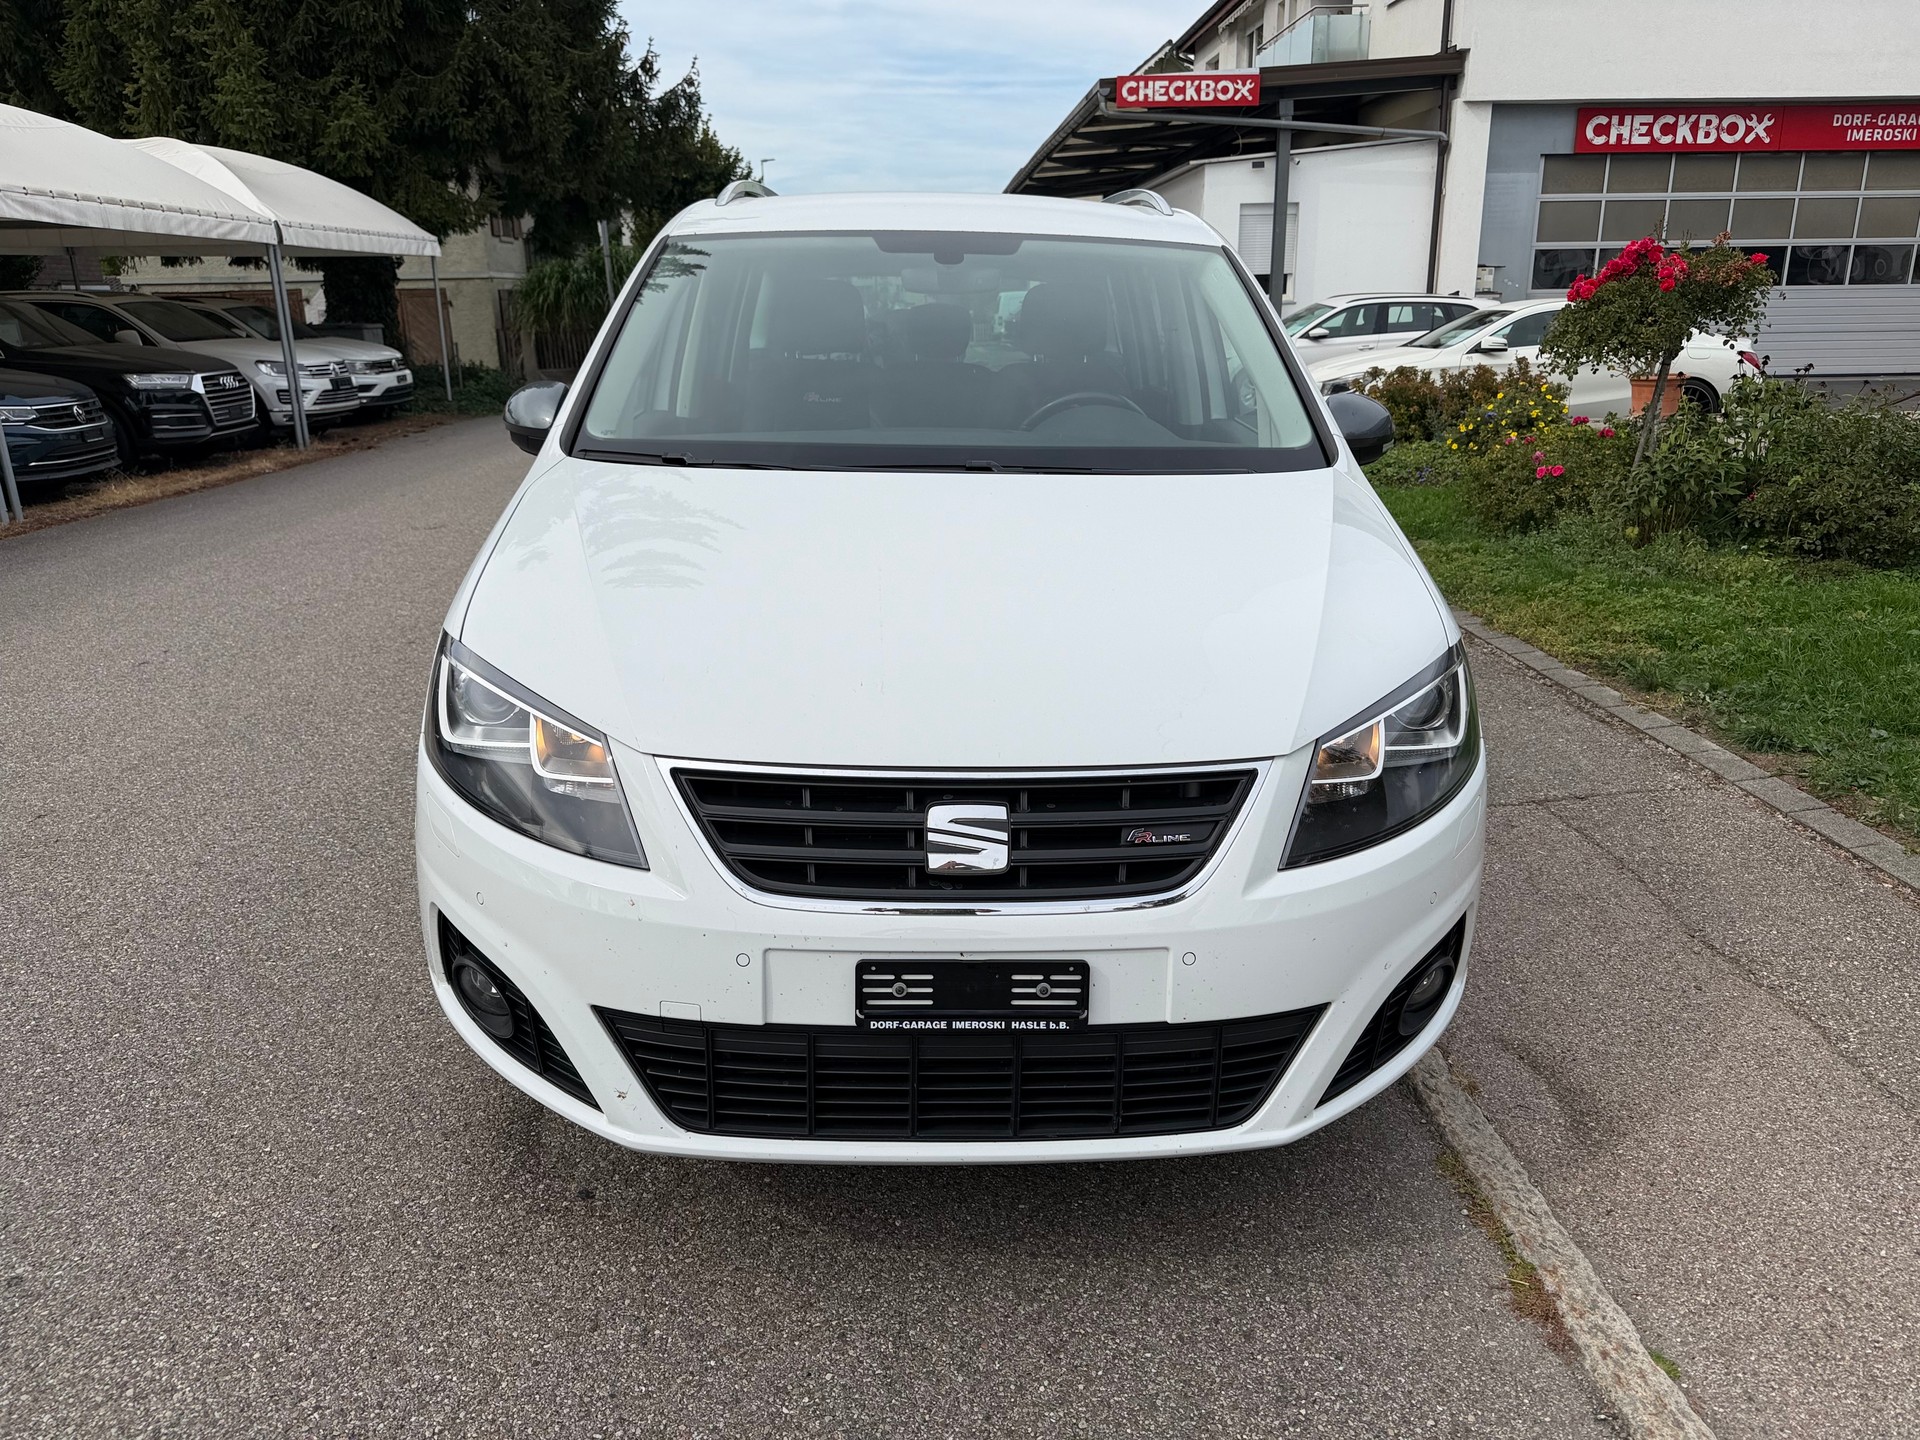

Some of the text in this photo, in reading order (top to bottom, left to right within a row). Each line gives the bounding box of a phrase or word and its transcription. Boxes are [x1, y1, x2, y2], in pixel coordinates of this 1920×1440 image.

[1121, 79, 1255, 102] CHECKBOX
[1832, 113, 1920, 127] DORF-GARA
[1585, 113, 1775, 146] CHECKBOX
[1846, 128, 1918, 142] IMEROSKI
[870, 1021, 1070, 1029] DORF-GARAGE IMEROSKI HASLE b.B.
